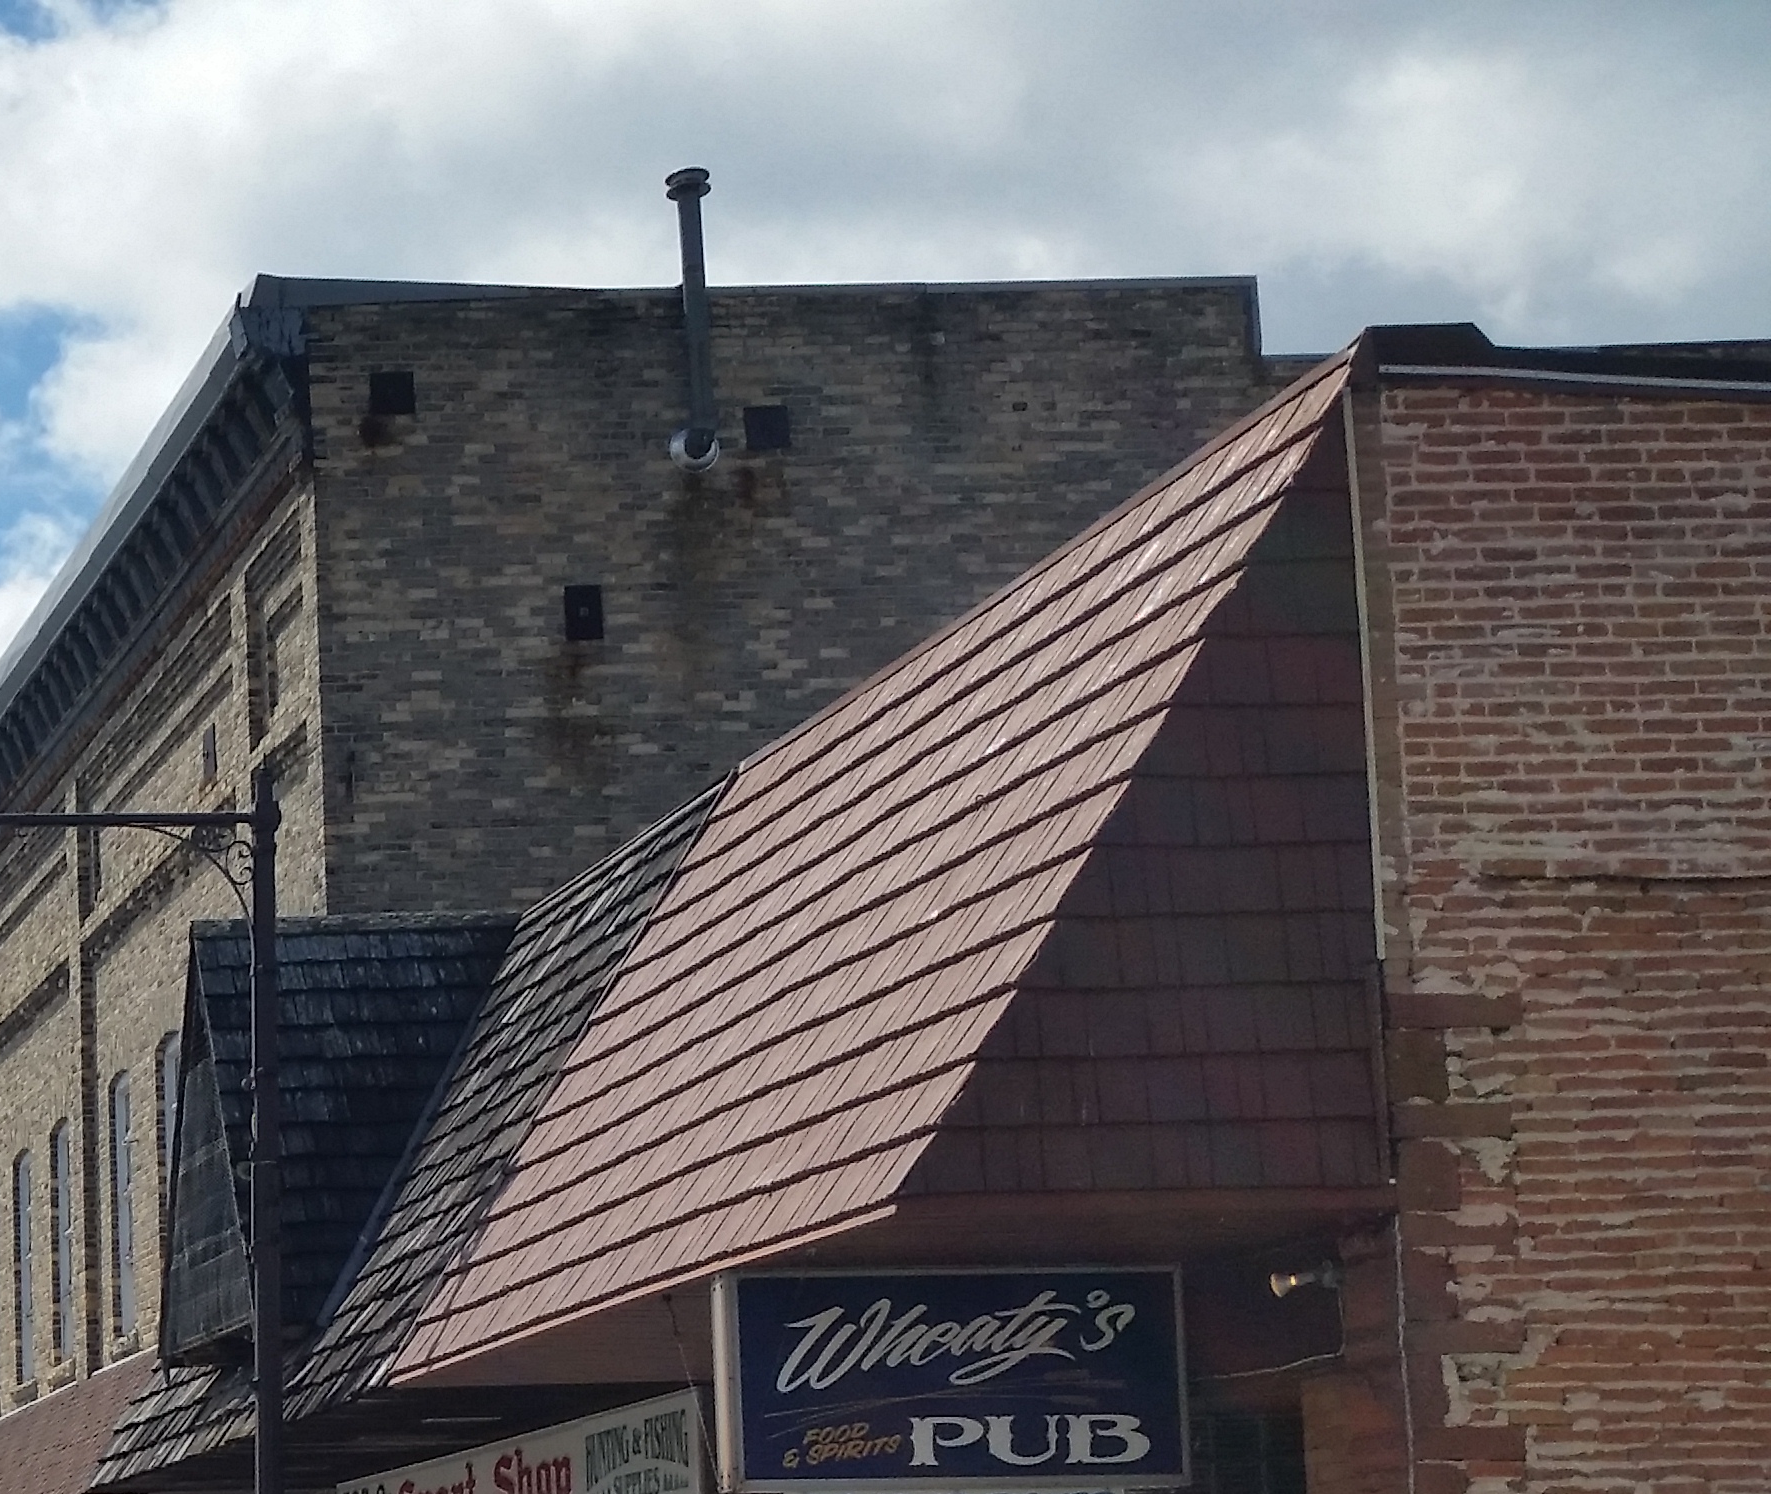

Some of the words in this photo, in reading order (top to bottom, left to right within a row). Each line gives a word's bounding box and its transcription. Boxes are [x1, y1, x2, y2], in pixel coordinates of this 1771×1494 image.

[776, 1289, 1135, 1394] Wheaty's
[585, 1424, 629, 1492] HUNTING
[632, 1428, 642, 1455] &
[644, 1409, 689, 1468] FISHING
[783, 1448, 800, 1469] &
[806, 1434, 902, 1465] SPIRITS
[803, 1422, 869, 1444] FOOD
[909, 1414, 1151, 1466] PUB
